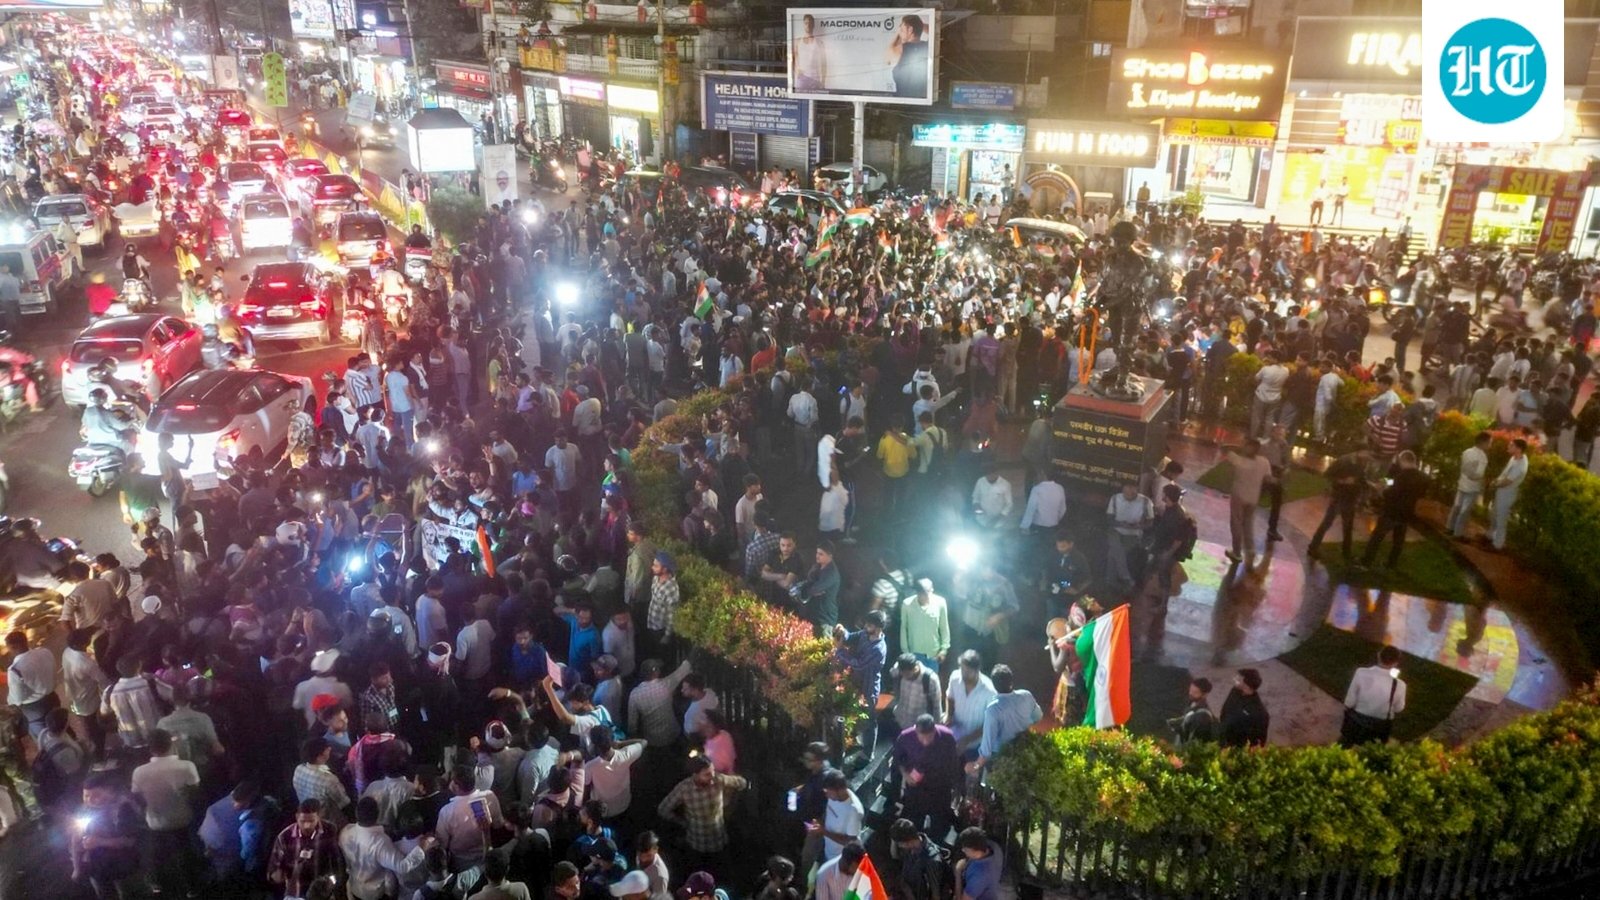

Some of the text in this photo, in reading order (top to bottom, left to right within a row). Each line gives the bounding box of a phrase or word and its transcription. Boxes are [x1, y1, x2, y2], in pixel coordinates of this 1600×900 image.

[820, 20, 881, 28] MACROMAN
[714, 83, 761, 97] HEALTH
[1166, 134, 1269, 146] GRAND ANNUAL SALE
[1395, 126, 1418, 141] SALE
[1034, 130, 1075, 153] FUN
[1078, 131, 1094, 155] N
[1098, 132, 1150, 157] FOOD
[1508, 171, 1558, 195] SALE
